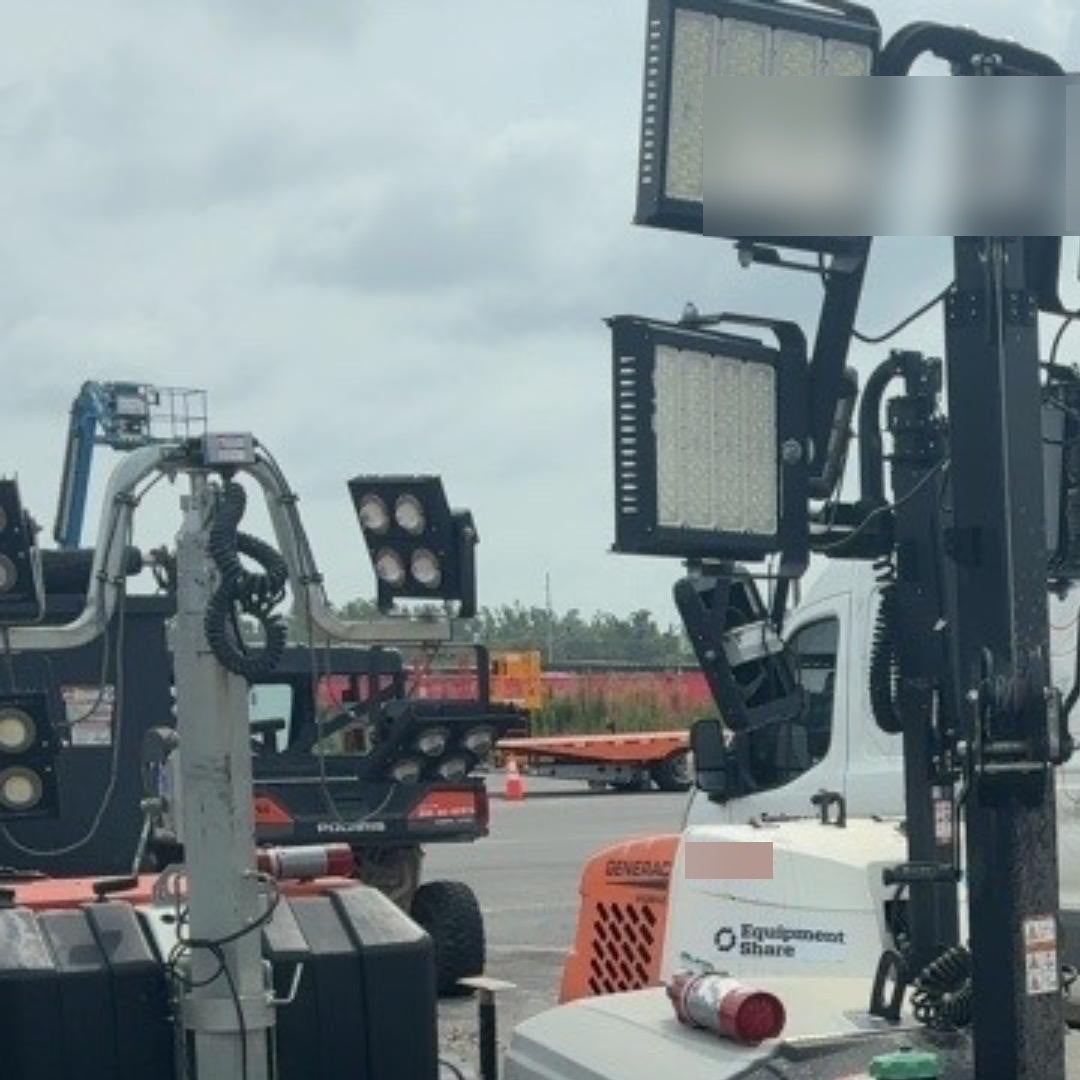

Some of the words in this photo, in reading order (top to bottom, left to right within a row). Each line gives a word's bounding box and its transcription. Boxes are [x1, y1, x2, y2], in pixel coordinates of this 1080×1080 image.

[606, 860, 672, 877] GENERAC
[740, 923, 846, 944] Equipment
[740, 942, 796, 958] Share
